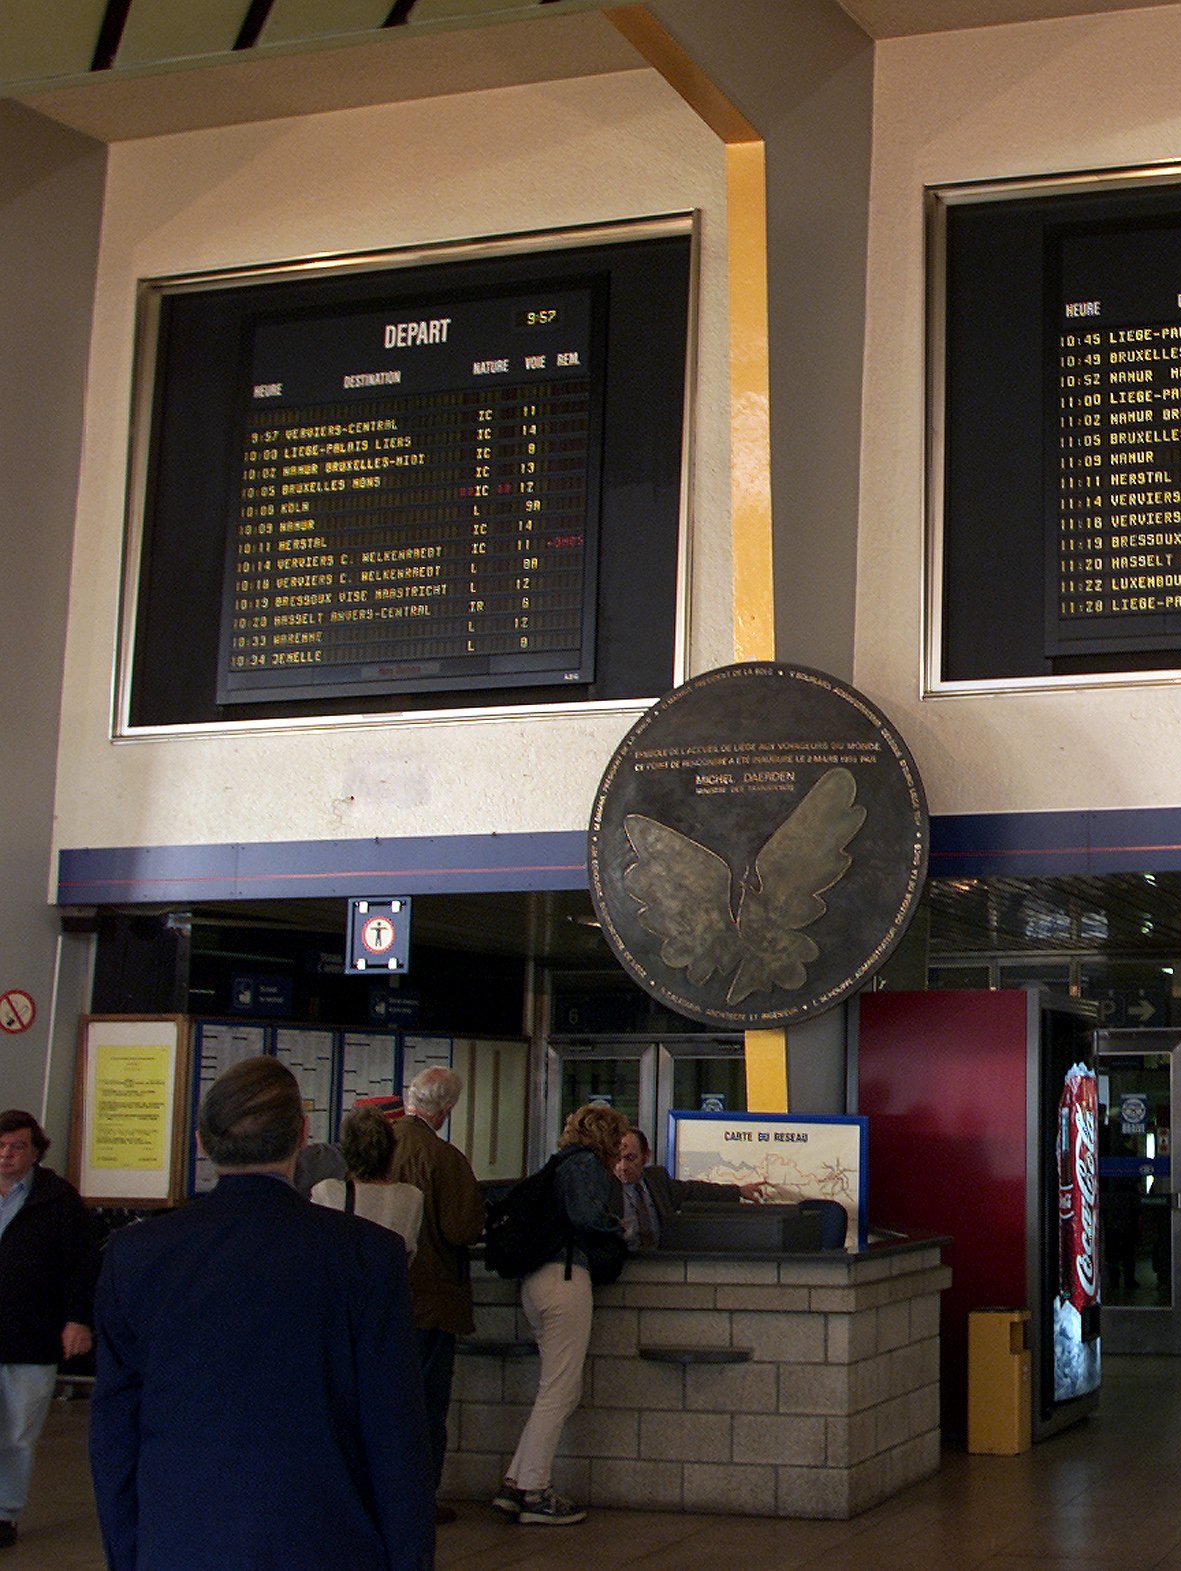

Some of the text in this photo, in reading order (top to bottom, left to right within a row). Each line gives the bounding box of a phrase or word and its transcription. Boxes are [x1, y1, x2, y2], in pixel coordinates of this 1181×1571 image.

[528, 310, 556, 324] 9:57
[1066, 302, 1100, 317] HEURE
[384, 319, 451, 348] DEPART
[1061, 334, 1100, 346] 10:45
[1062, 354, 1100, 367] 10:49
[254, 355, 545, 398] HEURE DESTINATION NATURE VOIE
[1061, 374, 1100, 387] 10:52
[1110, 370, 1152, 383] NAMUR
[1062, 394, 1100, 408] 11:00
[479, 410, 492, 421] IC
[524, 406, 535, 416] 11
[1061, 414, 1100, 427] 11:02
[1111, 410, 1152, 424] NAMUR
[477, 428, 491, 440] IC
[523, 425, 536, 435] 14
[1061, 434, 1100, 448] 11:05
[477, 448, 491, 458] IC
[1062, 455, 1101, 468] 11:09
[1111, 451, 1153, 465] NAMUR
[282, 480, 345, 495] BRUXELLES
[476, 466, 490, 477] IC
[1062, 476, 1099, 488] 11:11
[1111, 472, 1171, 485] HERSTAL
[475, 485, 488, 496] IC
[1062, 496, 1101, 509] 11:14
[1111, 491, 1180, 506] VERVIERS
[474, 506, 480, 516] L
[1111, 511, 1181, 528] VERVIERS
[474, 524, 487, 535] IC
[519, 520, 532, 530] 14
[1112, 533, 1181, 548] BRESSOUX
[472, 543, 485, 554] IC
[471, 564, 476, 573] L
[1062, 558, 1102, 572] 11:20
[1112, 554, 1172, 569] HASSELT
[470, 582, 476, 592] L
[517, 578, 529, 589] 12
[1062, 579, 1102, 592] 11:22
[470, 601, 483, 612] IR
[468, 617, 528, 632] L 12
[468, 641, 474, 651] L
[724, 1132, 808, 1143] CARTE DU RESEAU
